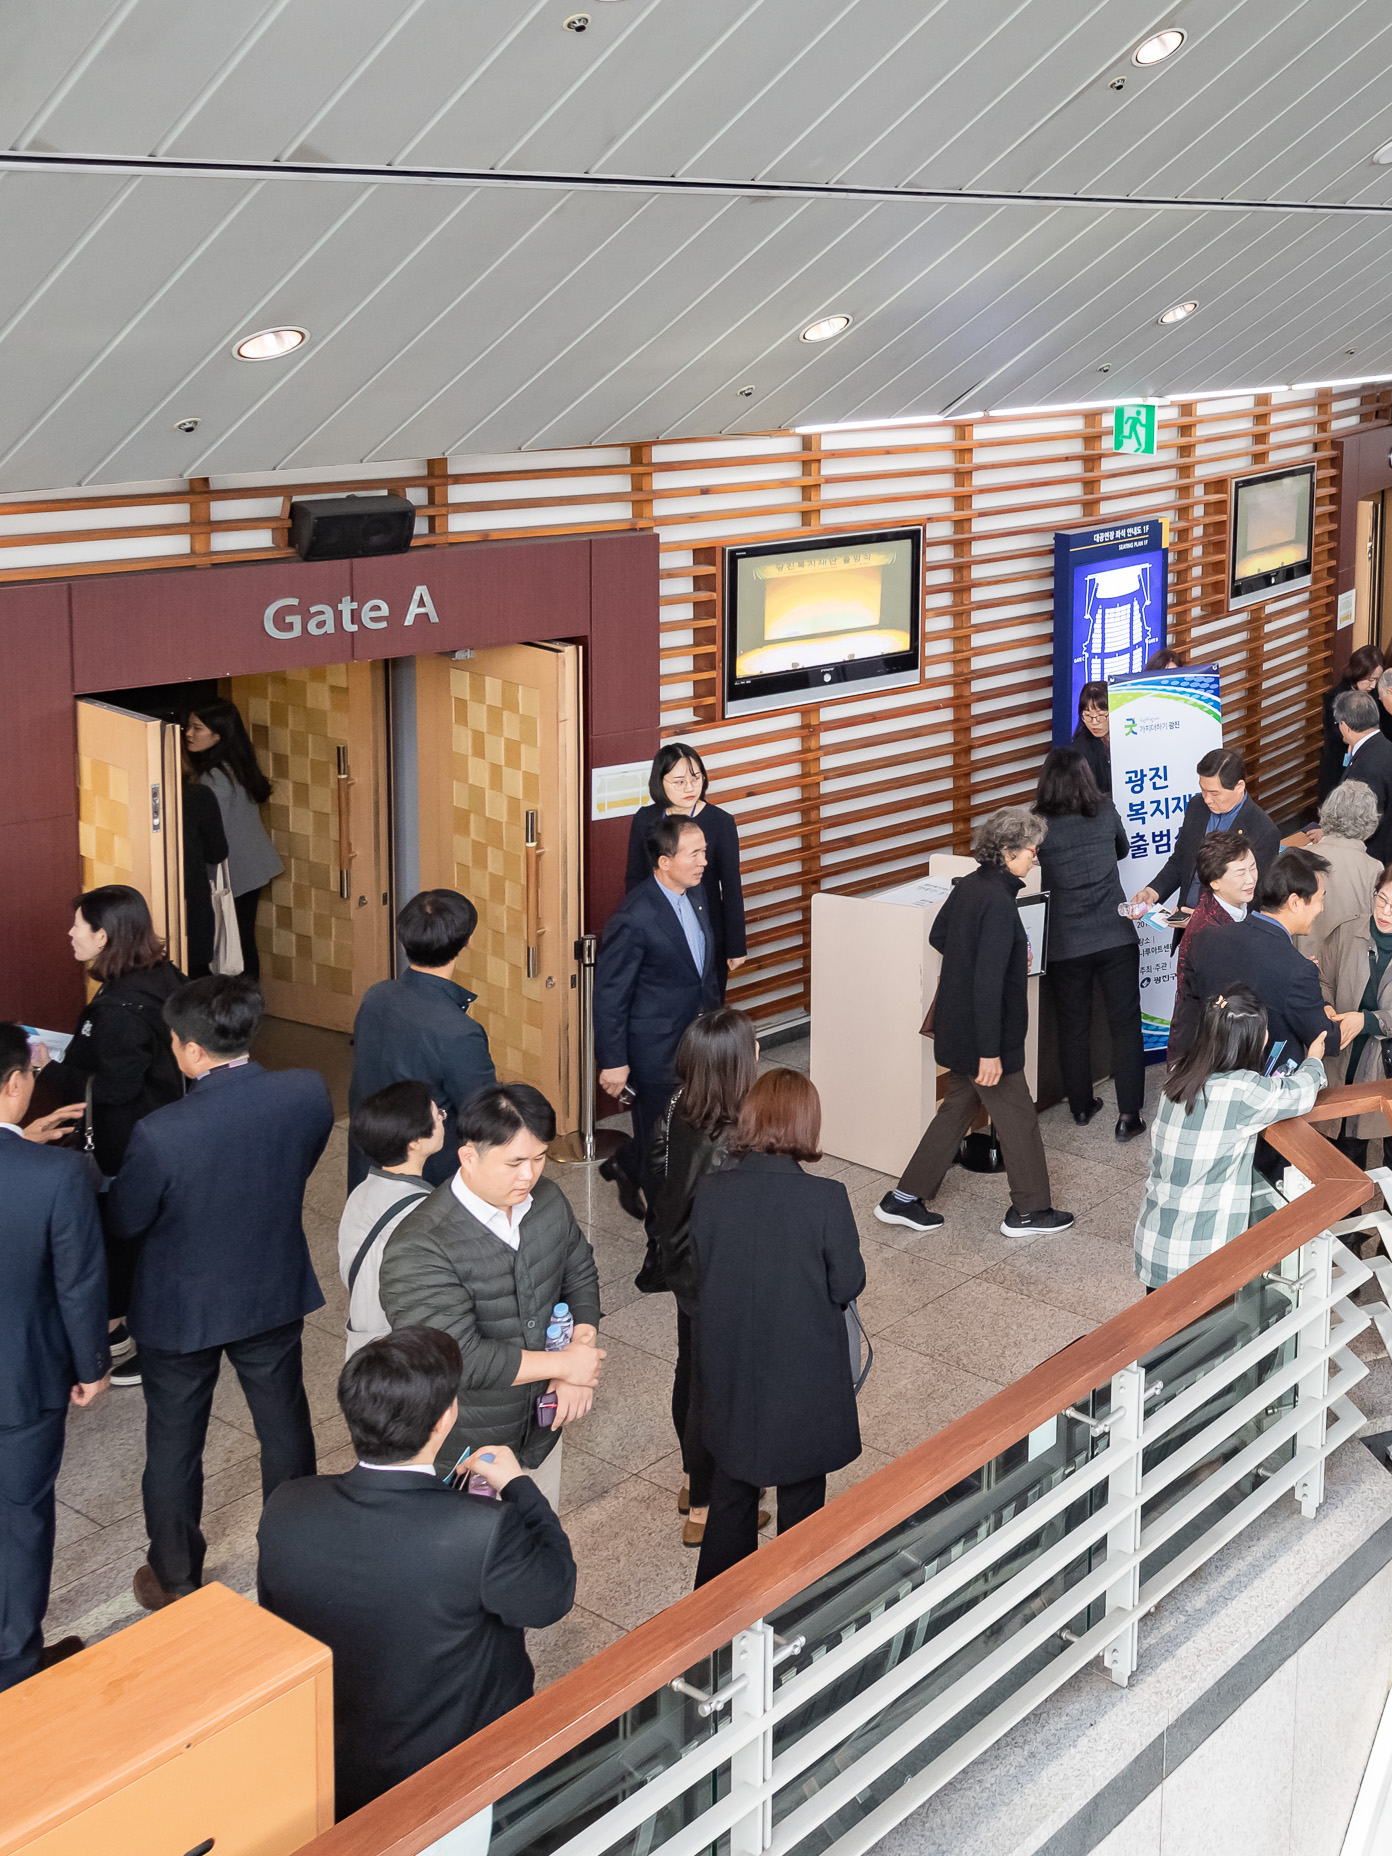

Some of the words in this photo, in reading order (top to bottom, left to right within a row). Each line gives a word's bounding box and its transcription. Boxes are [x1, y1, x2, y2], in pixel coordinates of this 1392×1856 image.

[1126, 525, 1143, 537] 안내도
[1143, 524, 1150, 534] 1F
[263, 596, 390, 640] Gate
[403, 585, 440, 626] A
[1140, 722, 1168, 733] 가치더하기
[1168, 720, 1180, 730] 광진
[1125, 765, 1169, 794] 광진
[1127, 793, 1202, 825] 복지재
[1129, 827, 1182, 859] 출범
